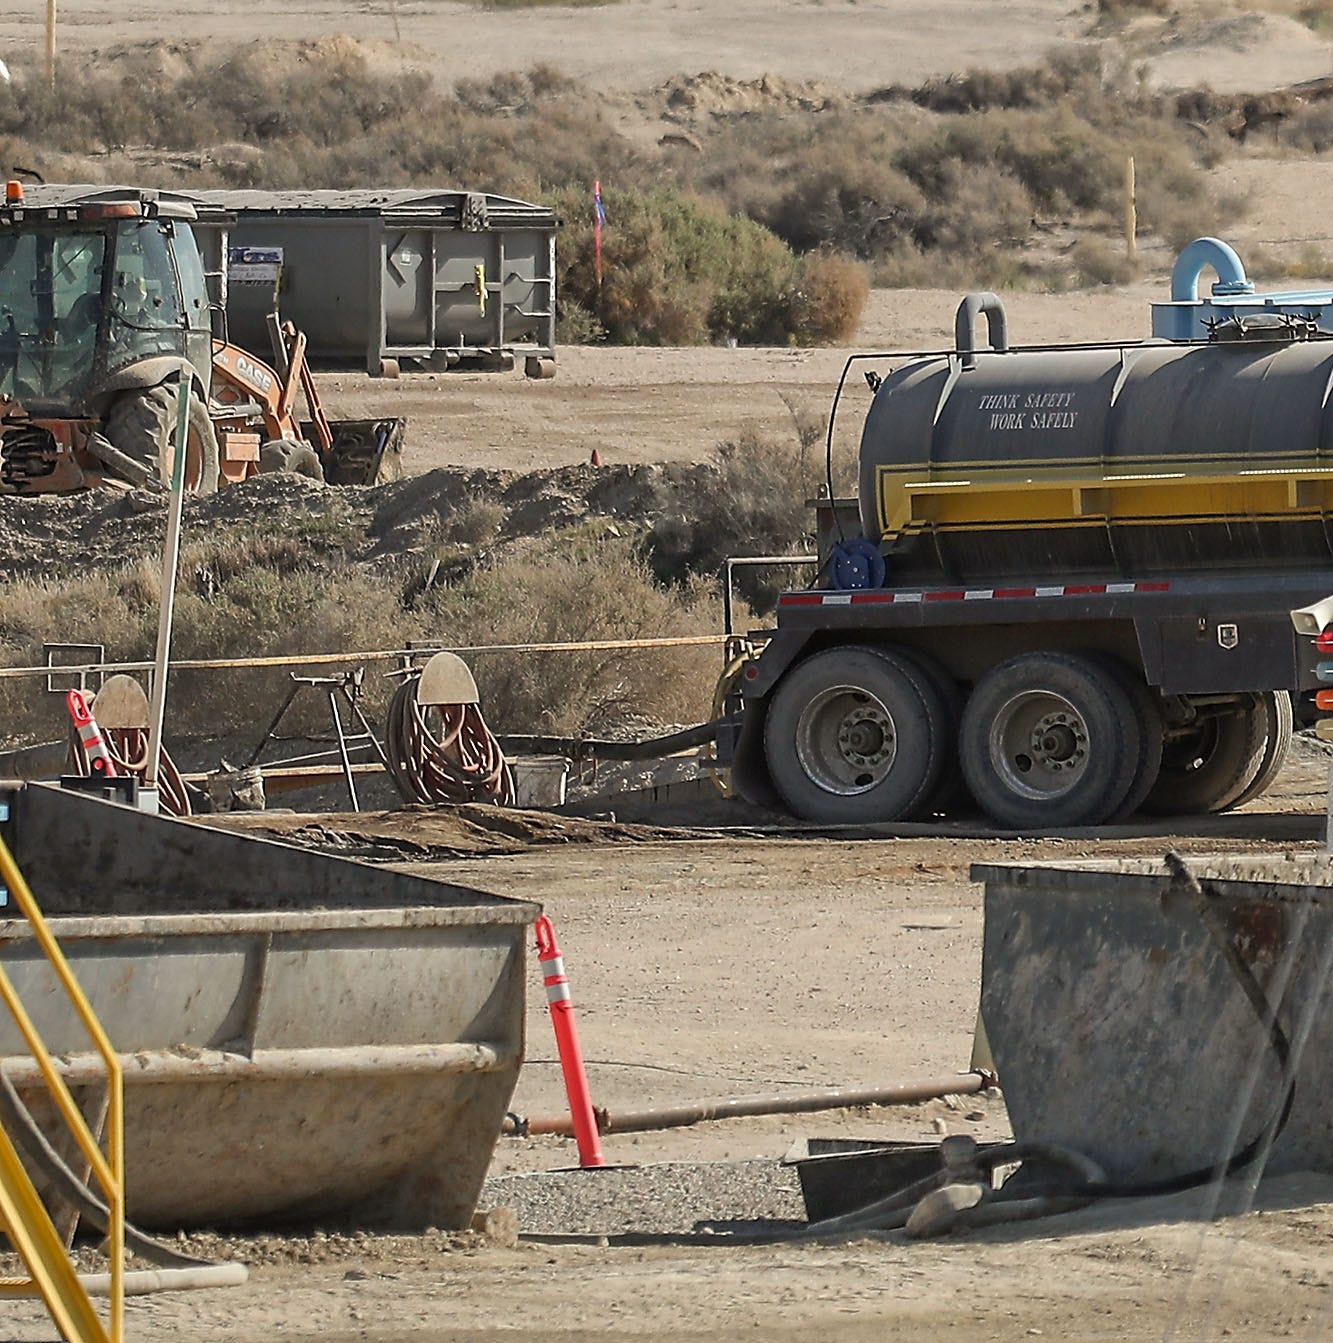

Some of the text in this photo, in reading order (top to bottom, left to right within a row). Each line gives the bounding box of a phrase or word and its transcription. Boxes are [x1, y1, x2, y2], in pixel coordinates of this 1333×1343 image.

[236, 356, 272, 393] CASE
[978, 392, 1076, 410] THINK SAFETY
[990, 411, 1078, 430] WORK SAFELY
